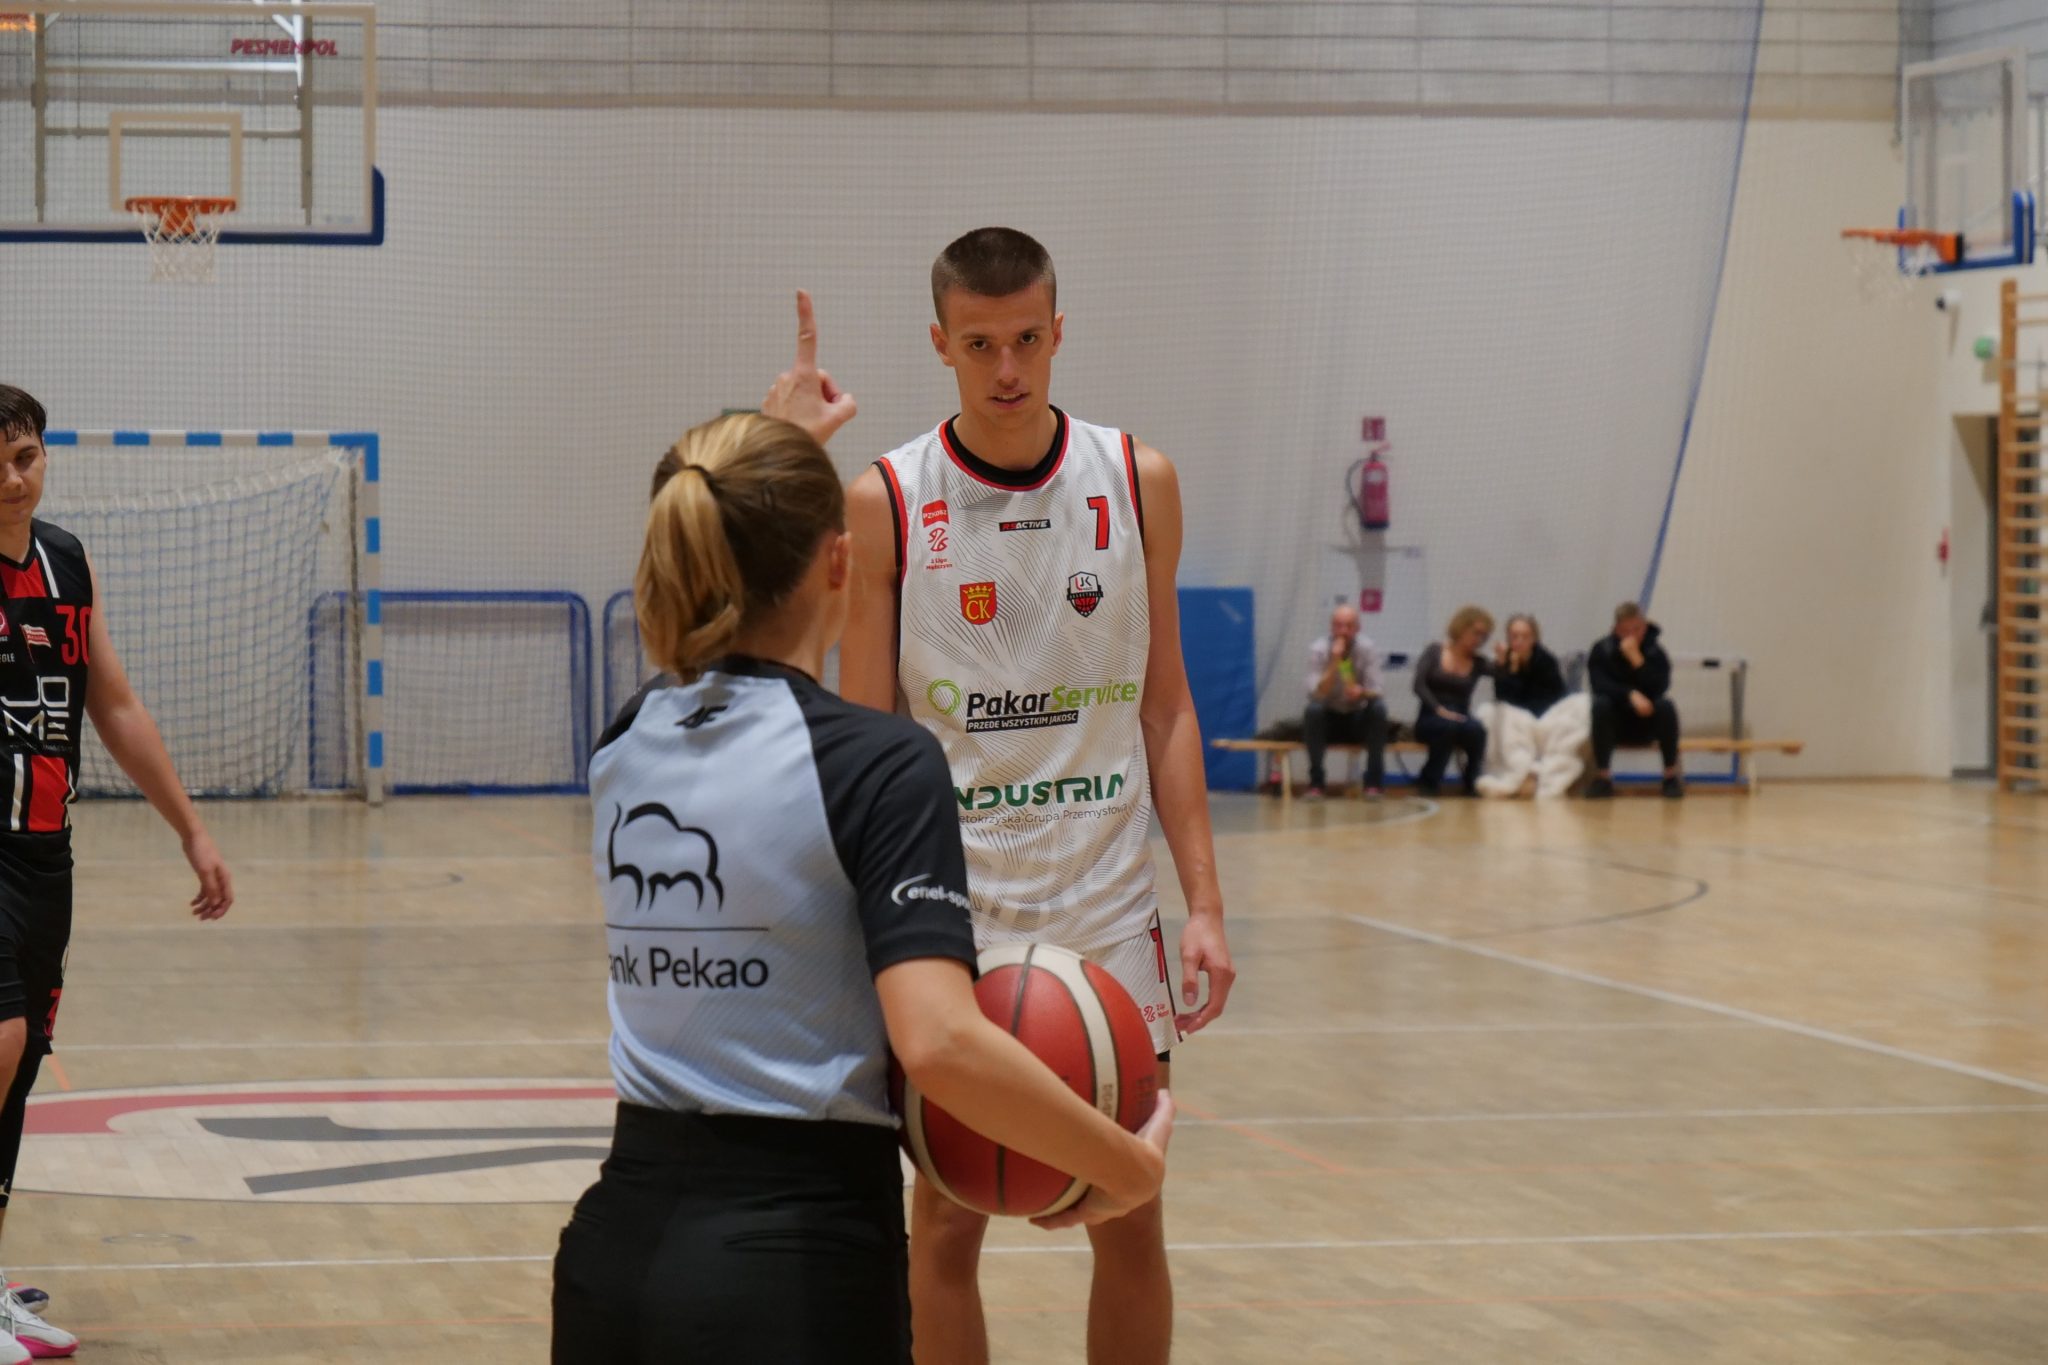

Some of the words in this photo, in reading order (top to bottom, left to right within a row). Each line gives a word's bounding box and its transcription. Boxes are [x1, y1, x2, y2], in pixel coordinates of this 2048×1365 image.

[966, 600, 990, 621] CK
[55, 605, 92, 665] 30
[966, 681, 1138, 717] PakarService
[953, 773, 1124, 811] NDUSTRIA
[609, 944, 642, 987] nk
[649, 947, 769, 988] Pekao
